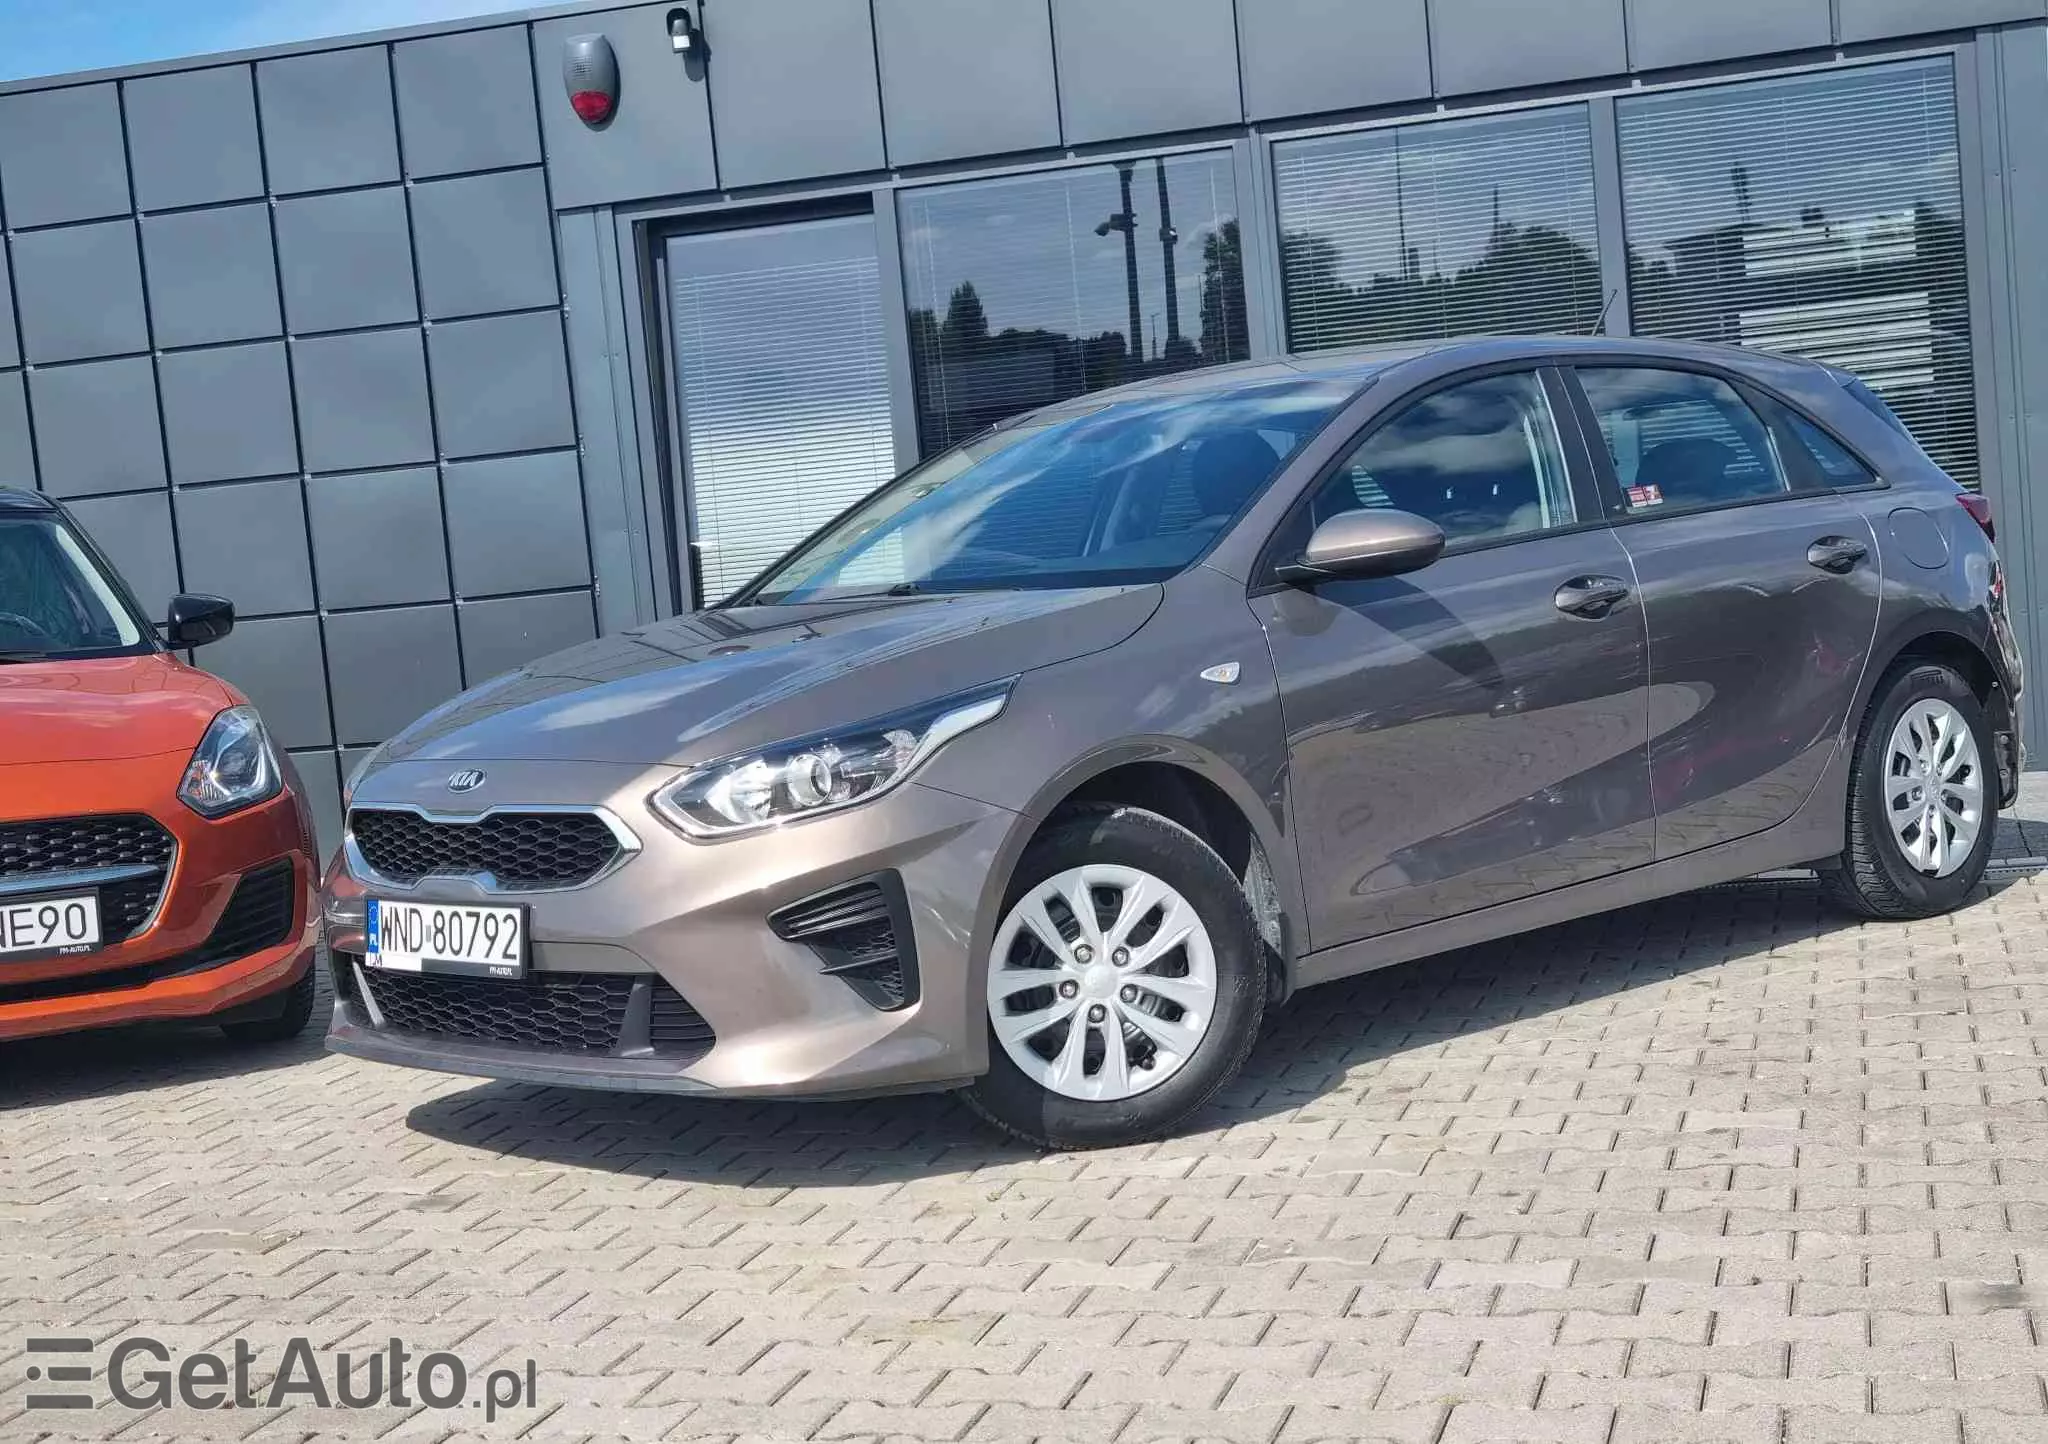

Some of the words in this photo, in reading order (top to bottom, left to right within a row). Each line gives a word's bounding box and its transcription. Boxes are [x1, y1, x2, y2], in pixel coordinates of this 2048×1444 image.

[448, 770, 479, 787] KIA
[0, 903, 87, 949] E90
[380, 905, 423, 953] WND
[433, 910, 518, 961] 80792
